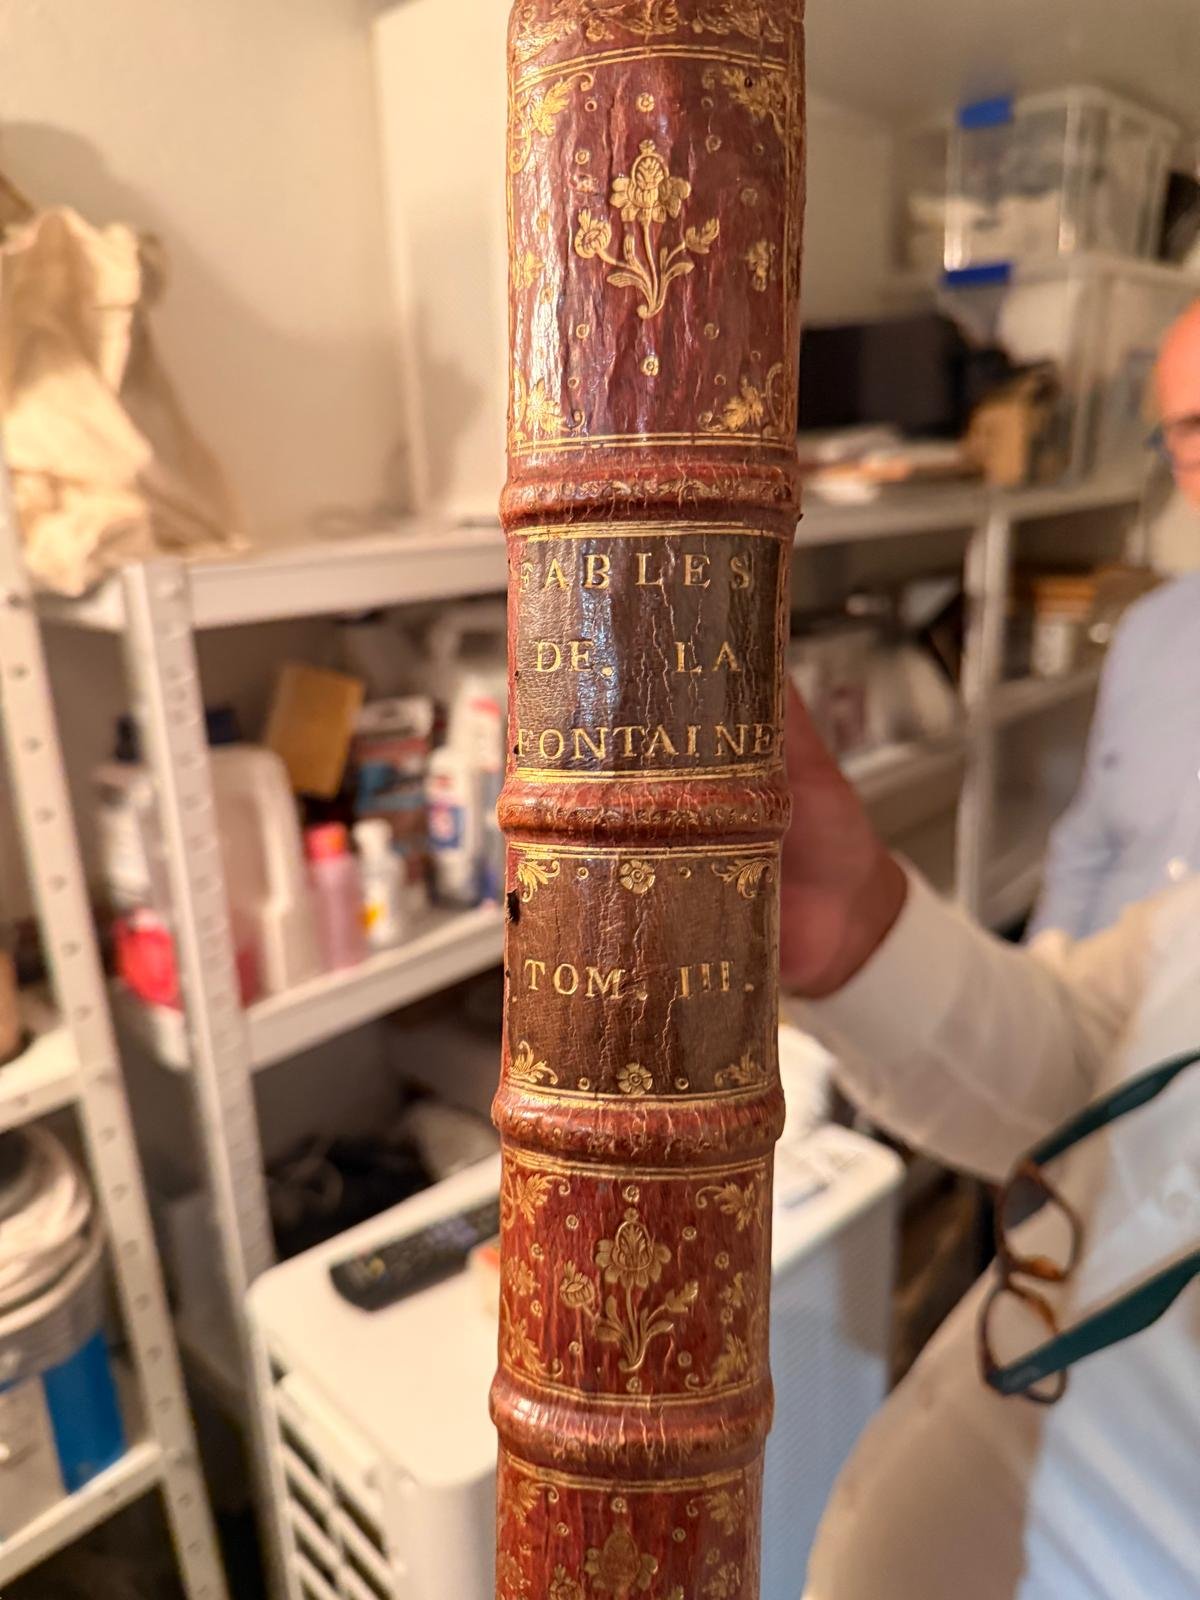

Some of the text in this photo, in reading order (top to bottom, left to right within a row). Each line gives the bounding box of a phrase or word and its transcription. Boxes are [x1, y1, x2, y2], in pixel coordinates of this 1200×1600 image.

[674, 640, 743, 674] LA
[517, 724, 775, 759] FONTAINE
[524, 959, 648, 1001] TOM.
